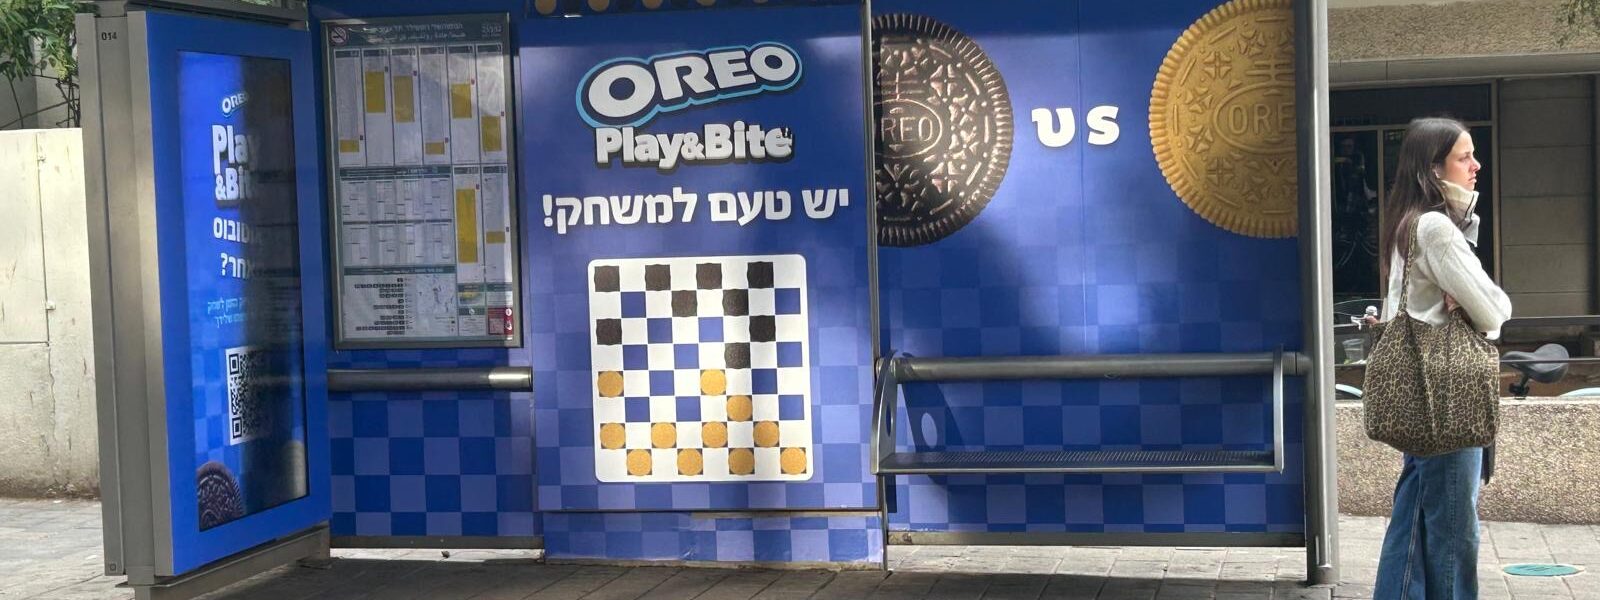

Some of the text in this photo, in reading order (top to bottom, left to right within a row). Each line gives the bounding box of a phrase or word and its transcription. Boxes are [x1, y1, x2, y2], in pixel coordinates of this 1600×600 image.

[588, 46, 796, 118] OREO
[881, 115, 934, 143] REO
[1229, 103, 1297, 136] ORE
[595, 121, 793, 169] Play&Bite
[542, 187, 849, 234] יש טעם למשחק!
